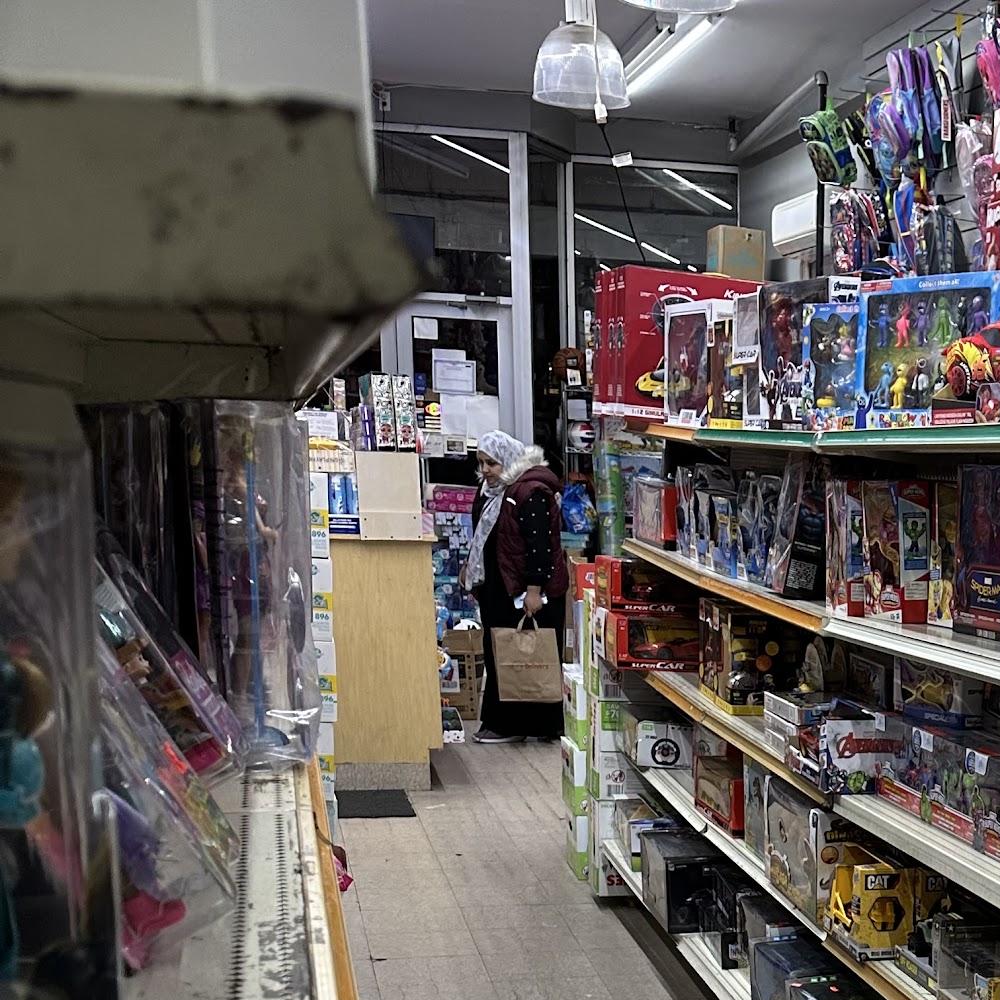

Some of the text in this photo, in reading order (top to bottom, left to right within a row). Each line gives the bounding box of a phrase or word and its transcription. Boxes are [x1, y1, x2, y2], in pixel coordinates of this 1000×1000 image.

[311, 530, 326, 538] 896
[315, 612, 329, 620] 896
[867, 875, 889, 889] CAT
